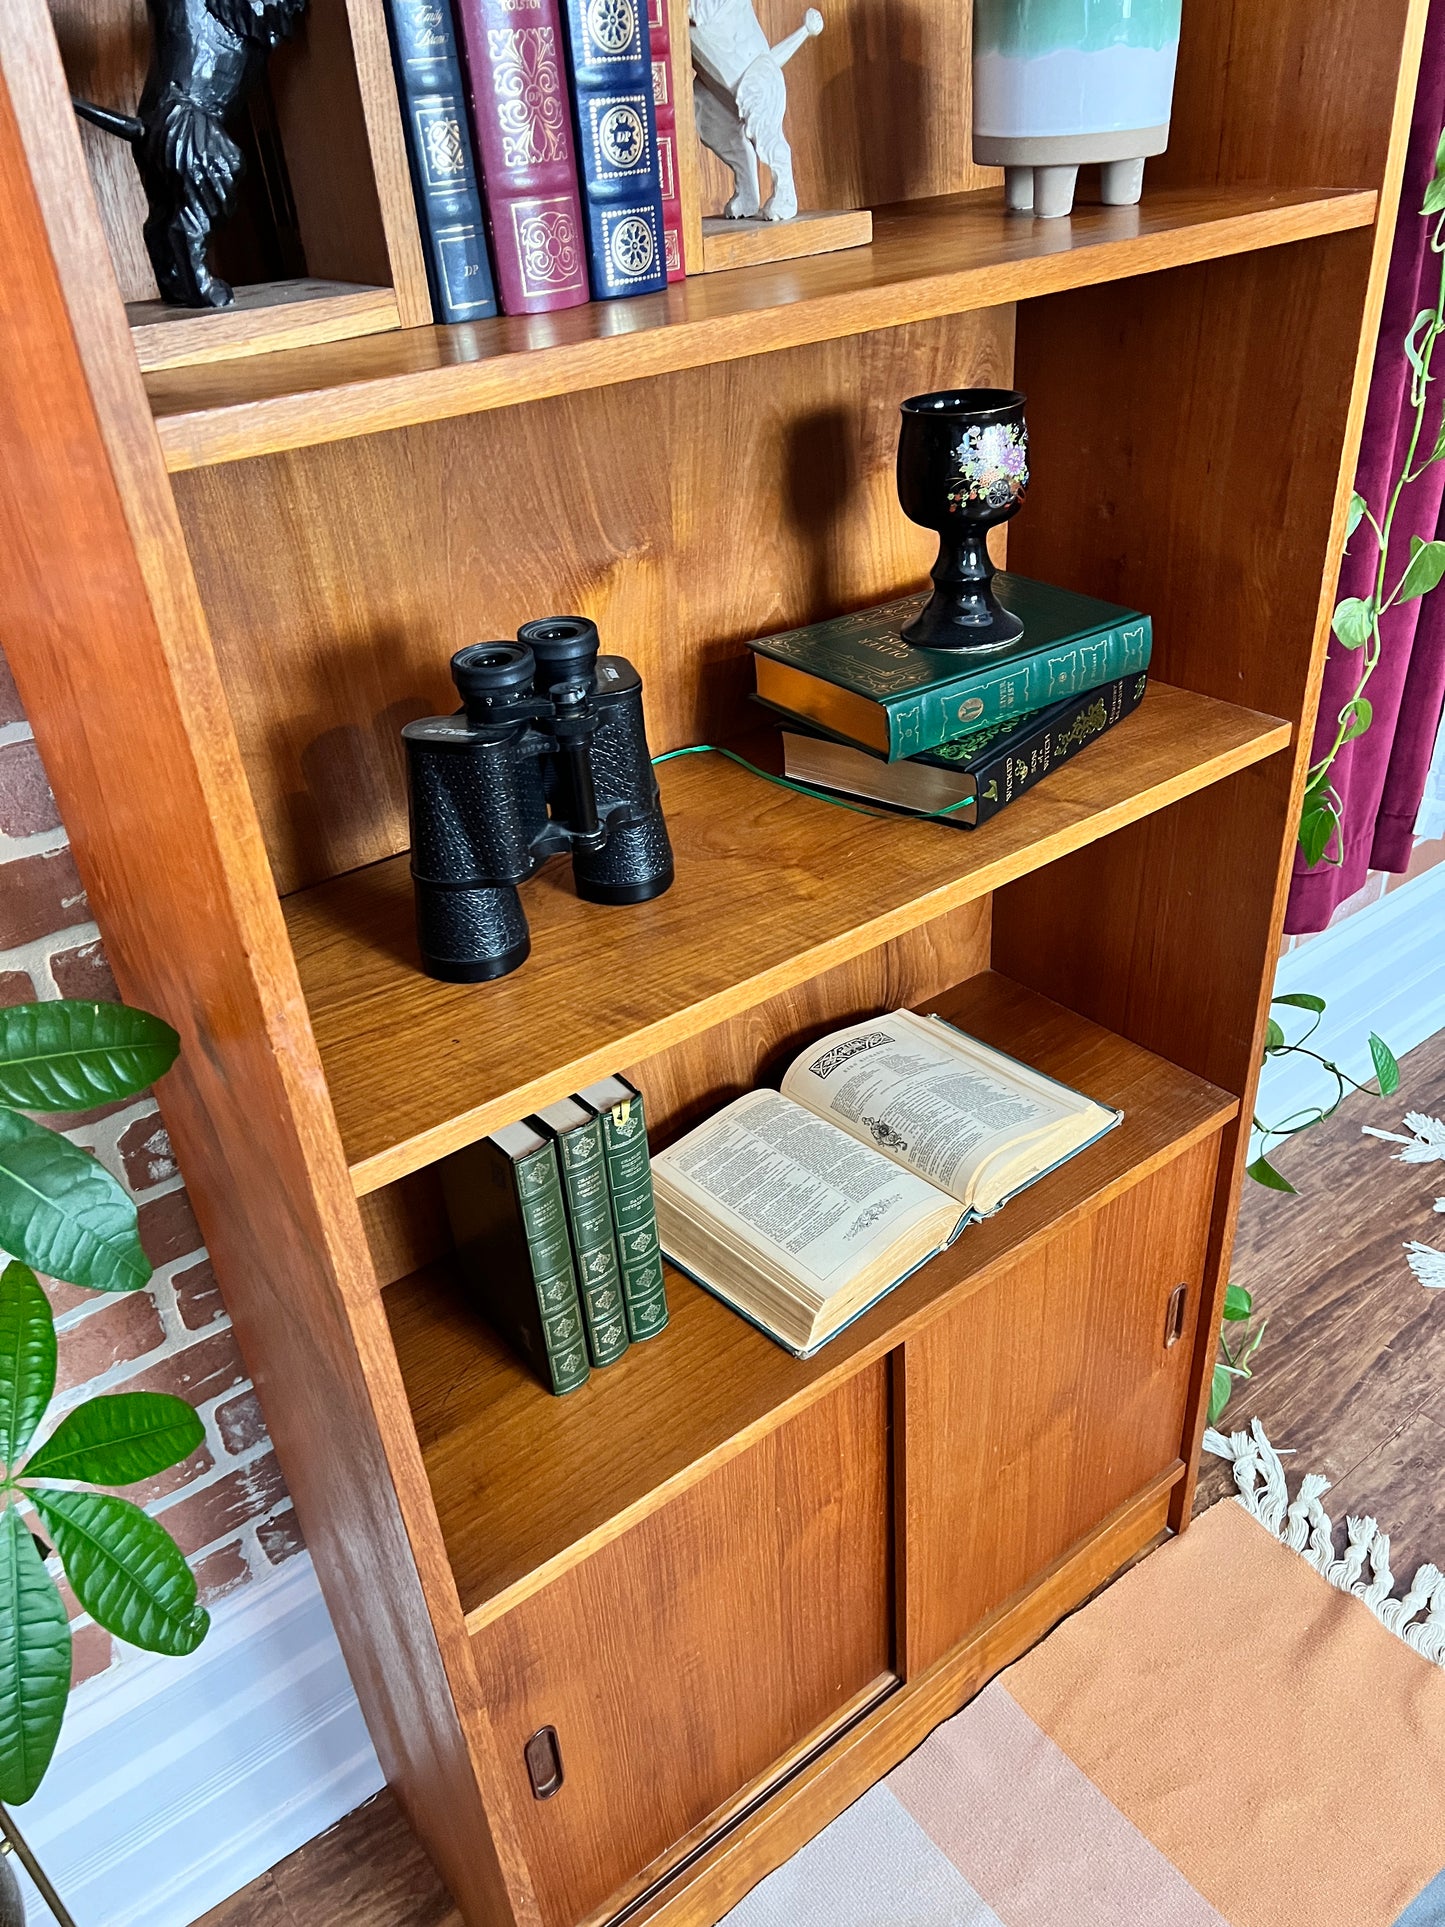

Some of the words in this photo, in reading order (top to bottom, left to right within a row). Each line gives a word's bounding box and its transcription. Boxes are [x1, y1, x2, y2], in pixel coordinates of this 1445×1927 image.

[414, 5, 444, 28] Emily
[616, 131, 632, 143] DP
[464, 264, 479, 277] DP
[858, 638, 909, 659] OLIVER
[1043, 733, 1051, 771] WITCH
[1005, 757, 1013, 802] WICKED
